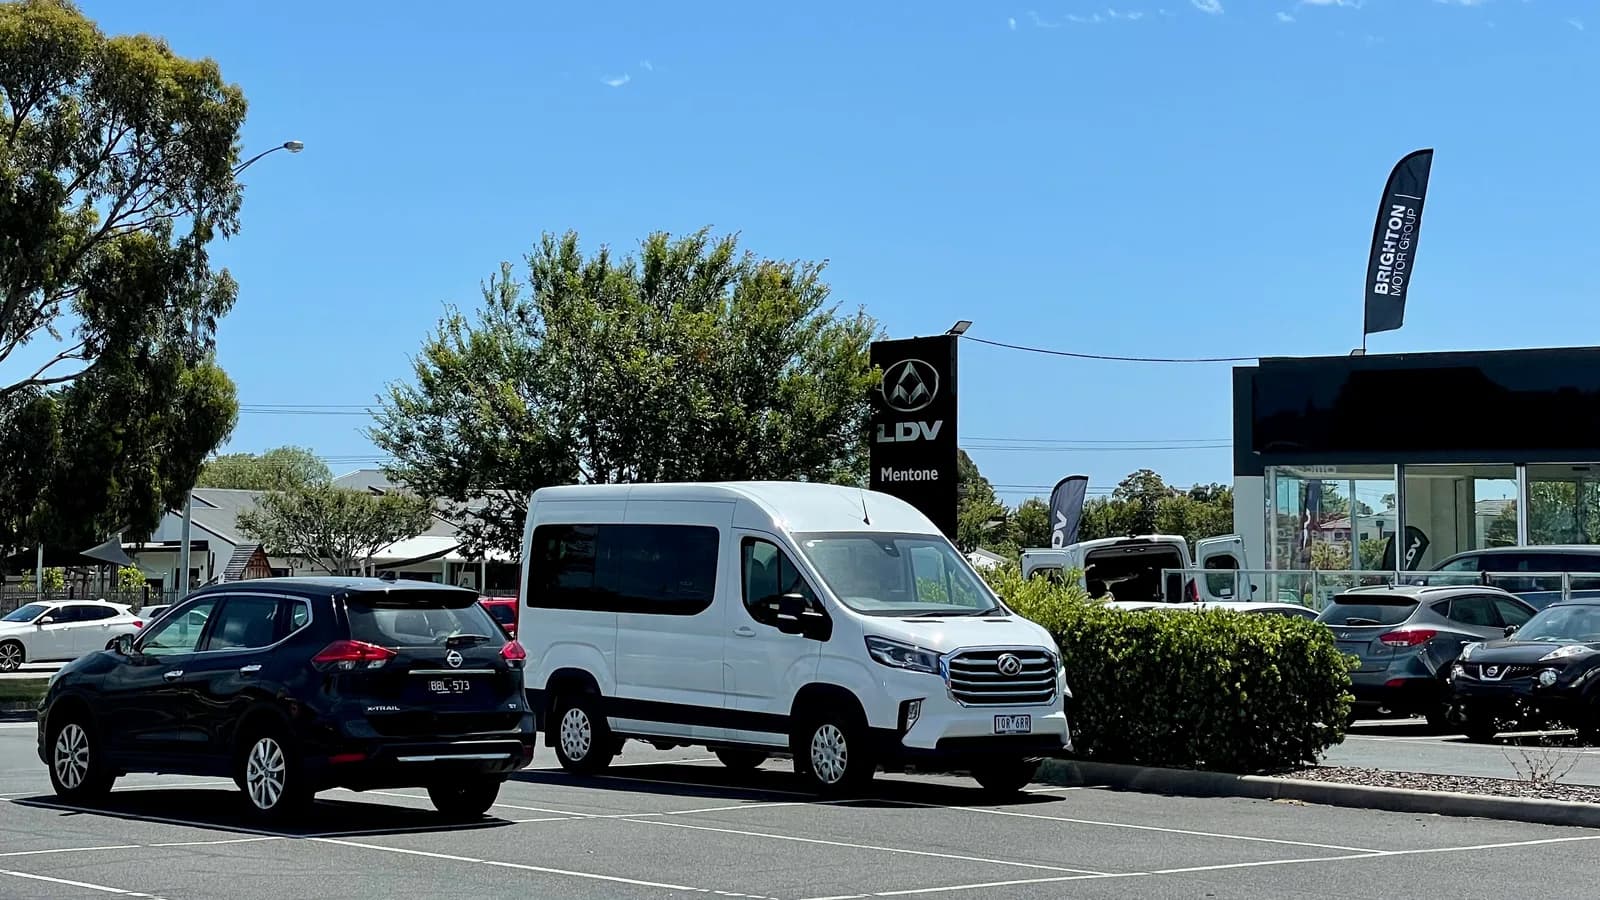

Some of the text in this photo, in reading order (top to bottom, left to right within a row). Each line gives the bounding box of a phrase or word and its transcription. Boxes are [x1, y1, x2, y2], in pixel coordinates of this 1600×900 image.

[1374, 204, 1406, 295] BRIGHTON
[1390, 208, 1417, 296] MOTOR GROUP
[877, 420, 943, 443] LDV
[881, 466, 939, 482] Mentone
[1051, 510, 1067, 549] DV
